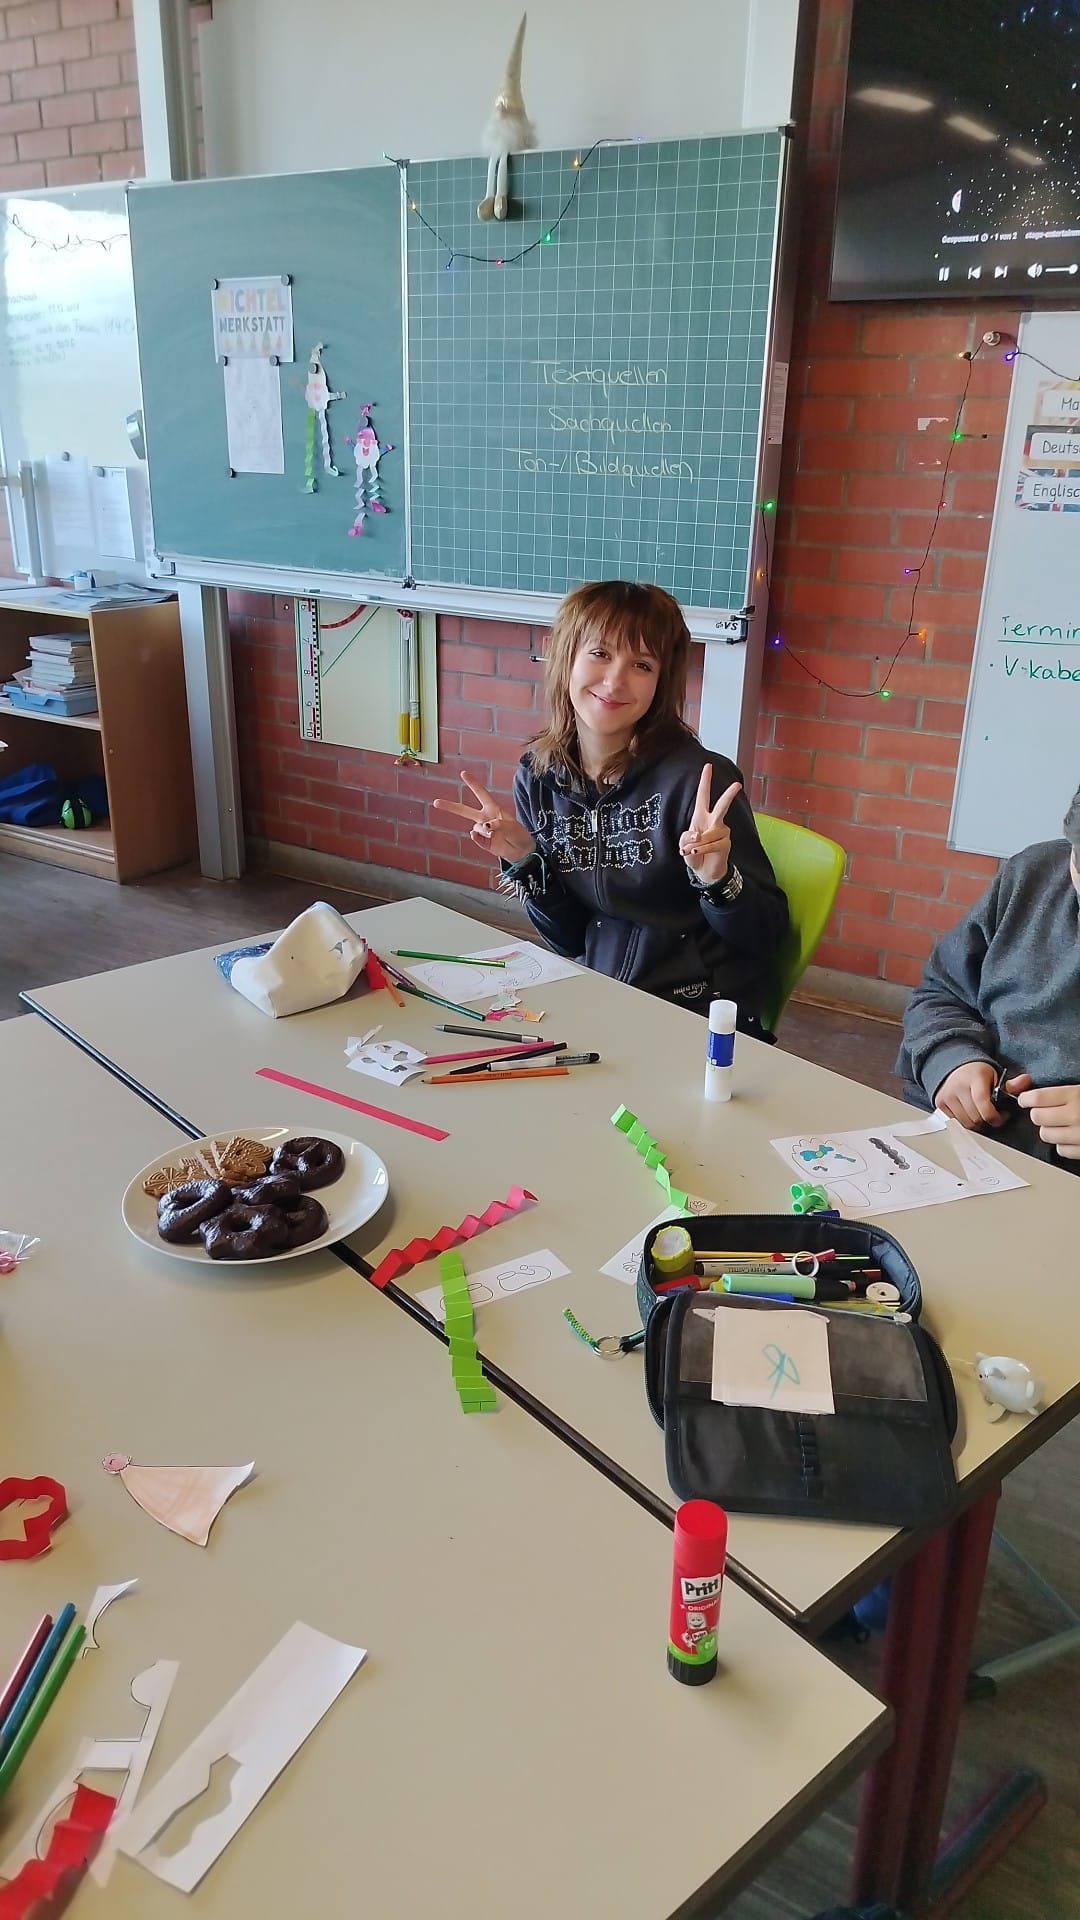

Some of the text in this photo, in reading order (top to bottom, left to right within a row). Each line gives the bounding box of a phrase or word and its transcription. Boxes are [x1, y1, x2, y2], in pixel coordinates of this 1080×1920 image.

[1012, 231, 1018, 240] 2
[219, 316, 286, 333] WERKSTATT
[531, 361, 668, 398] Textquellen
[549, 407, 671, 445] Sachquellen
[684, 1579, 719, 1596] Pritt
